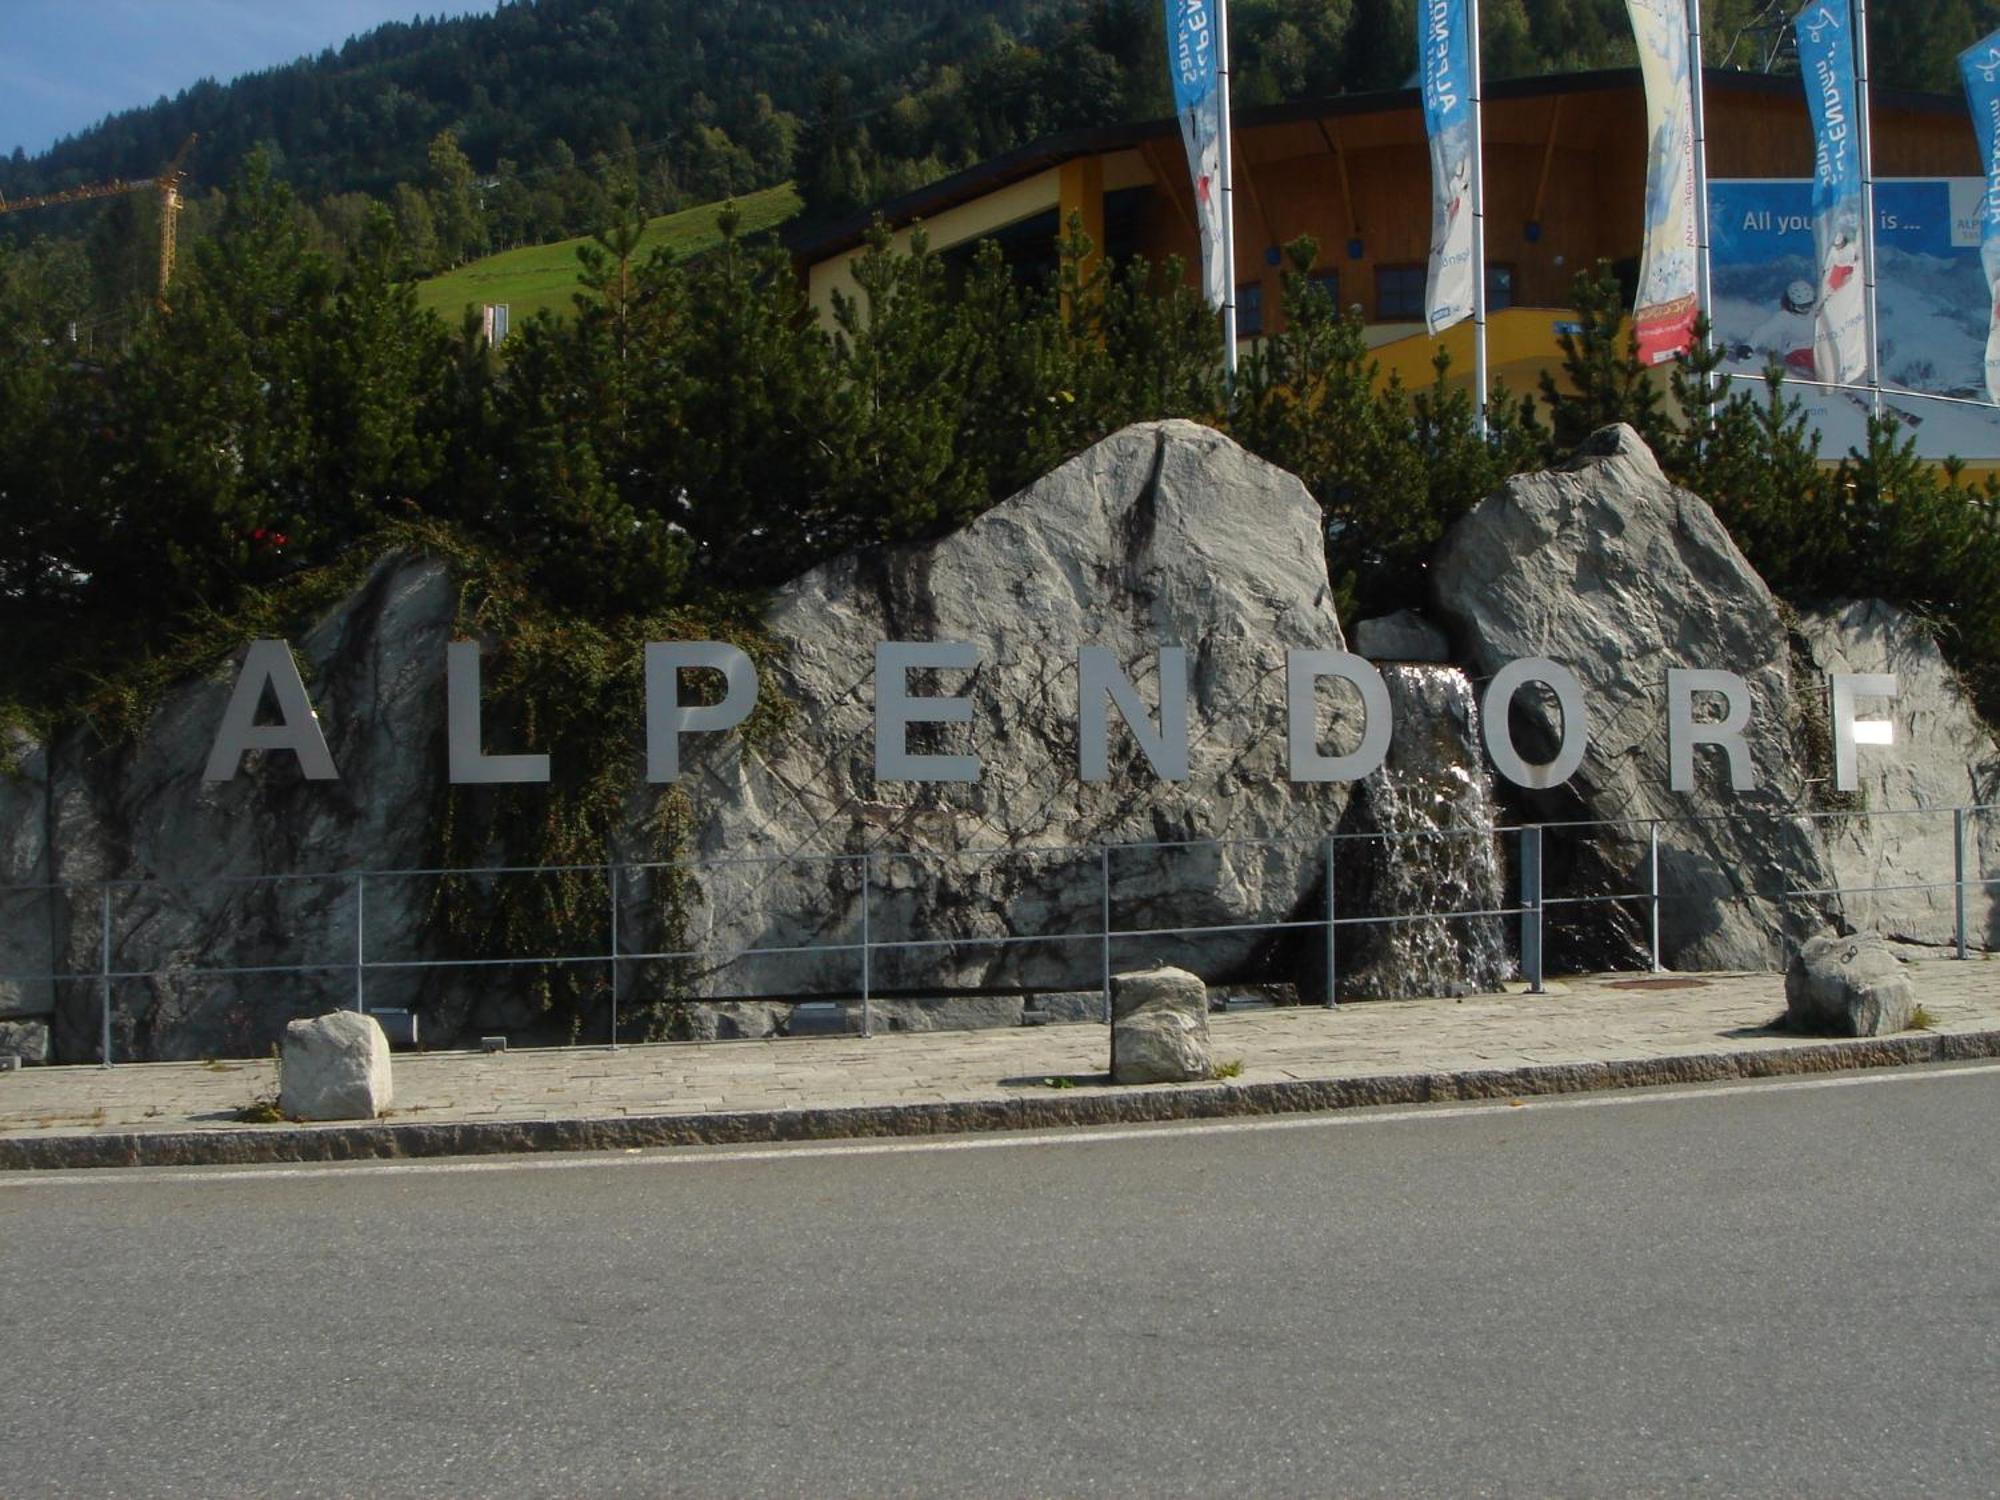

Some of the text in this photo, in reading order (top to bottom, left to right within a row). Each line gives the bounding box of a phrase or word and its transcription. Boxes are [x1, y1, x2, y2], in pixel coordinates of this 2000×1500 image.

[1743, 211, 1771, 231] All
[1881, 210, 1898, 230] is
[203, 638, 1897, 792] ALPENDORF
